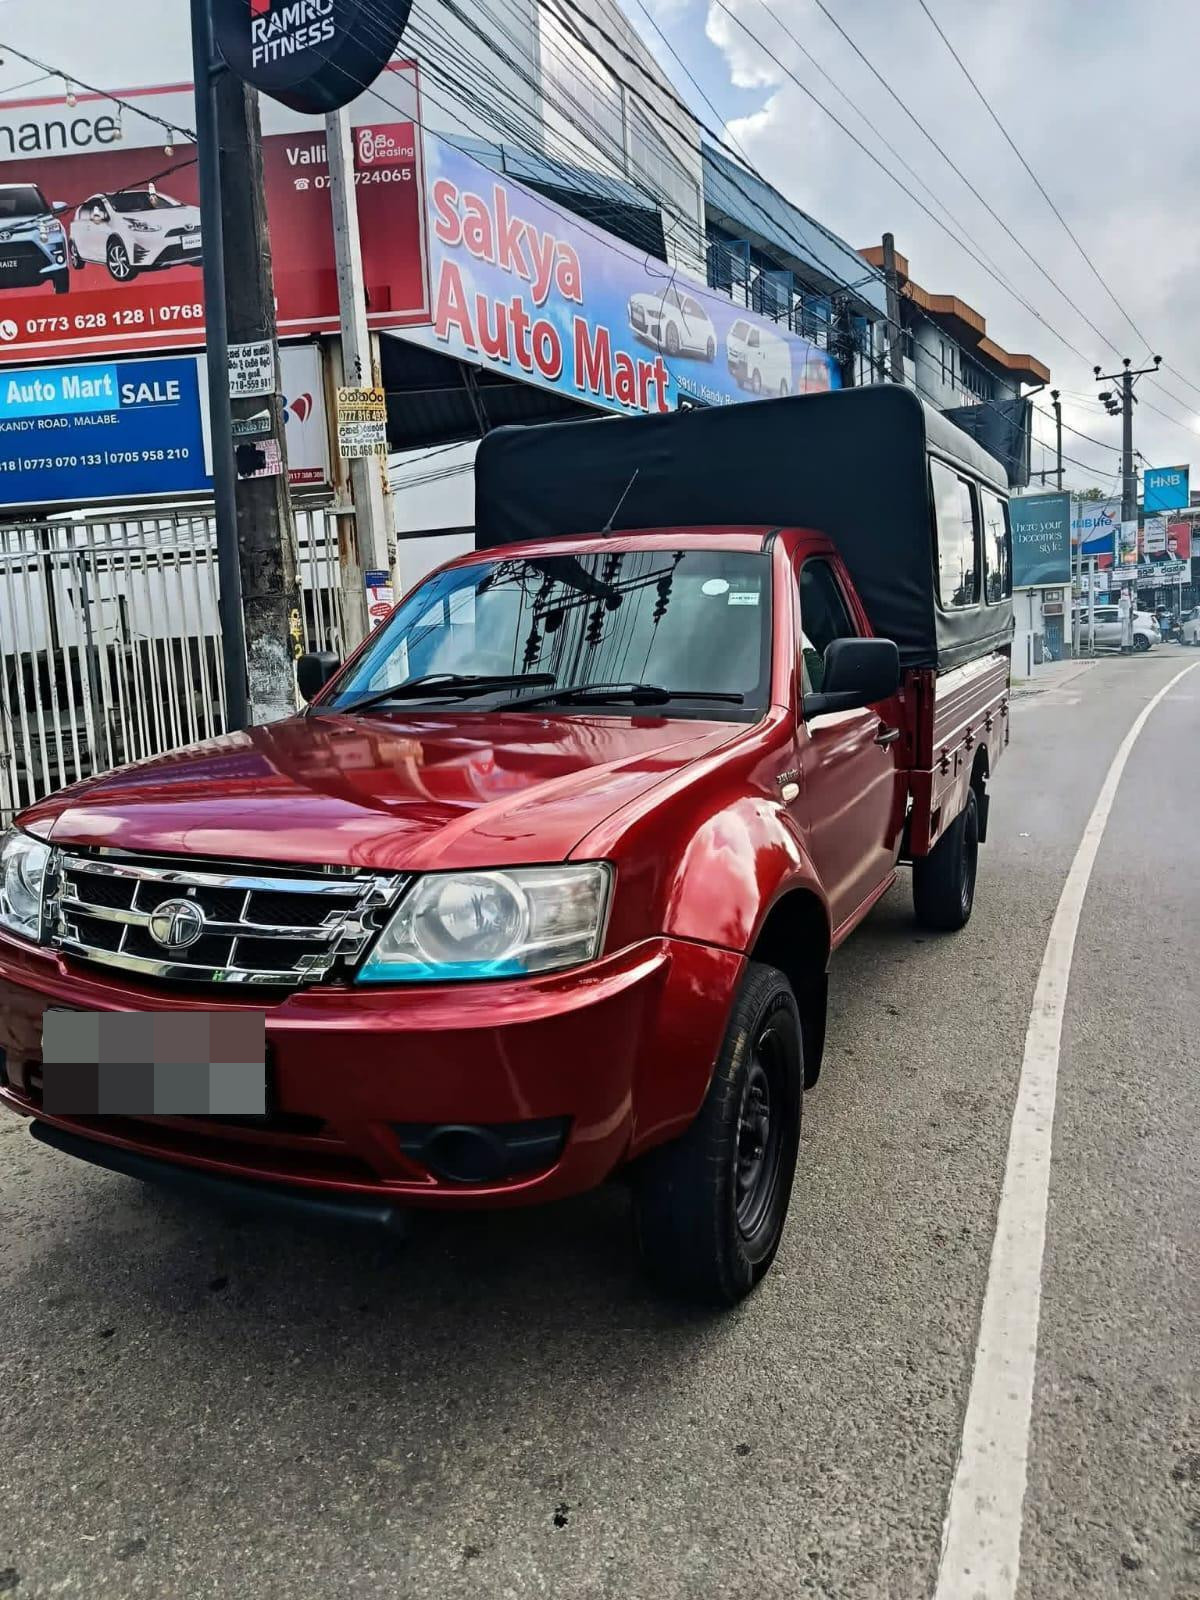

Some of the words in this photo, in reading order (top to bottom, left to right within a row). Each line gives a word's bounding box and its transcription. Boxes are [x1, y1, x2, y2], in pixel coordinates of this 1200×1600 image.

[252, 16, 335, 68] FITNESS
[375, 146, 414, 157] Leasing
[432, 179, 584, 307] sakya
[26, 317, 69, 334] 0773
[74, 313, 106, 330] 628
[112, 308, 145, 325] 128
[159, 303, 203, 320] 0768
[433, 259, 564, 381] Auto
[573, 313, 671, 415] Mart
[6, 378, 56, 404] Auto
[62, 372, 113, 399] Mart
[121, 380, 181, 404] SALE
[55, 456, 77, 468] 070
[80, 454, 101, 467] 133
[143, 449, 164, 461] 958
[167, 447, 189, 460] 210
[1150, 474, 1181, 489] HNB
